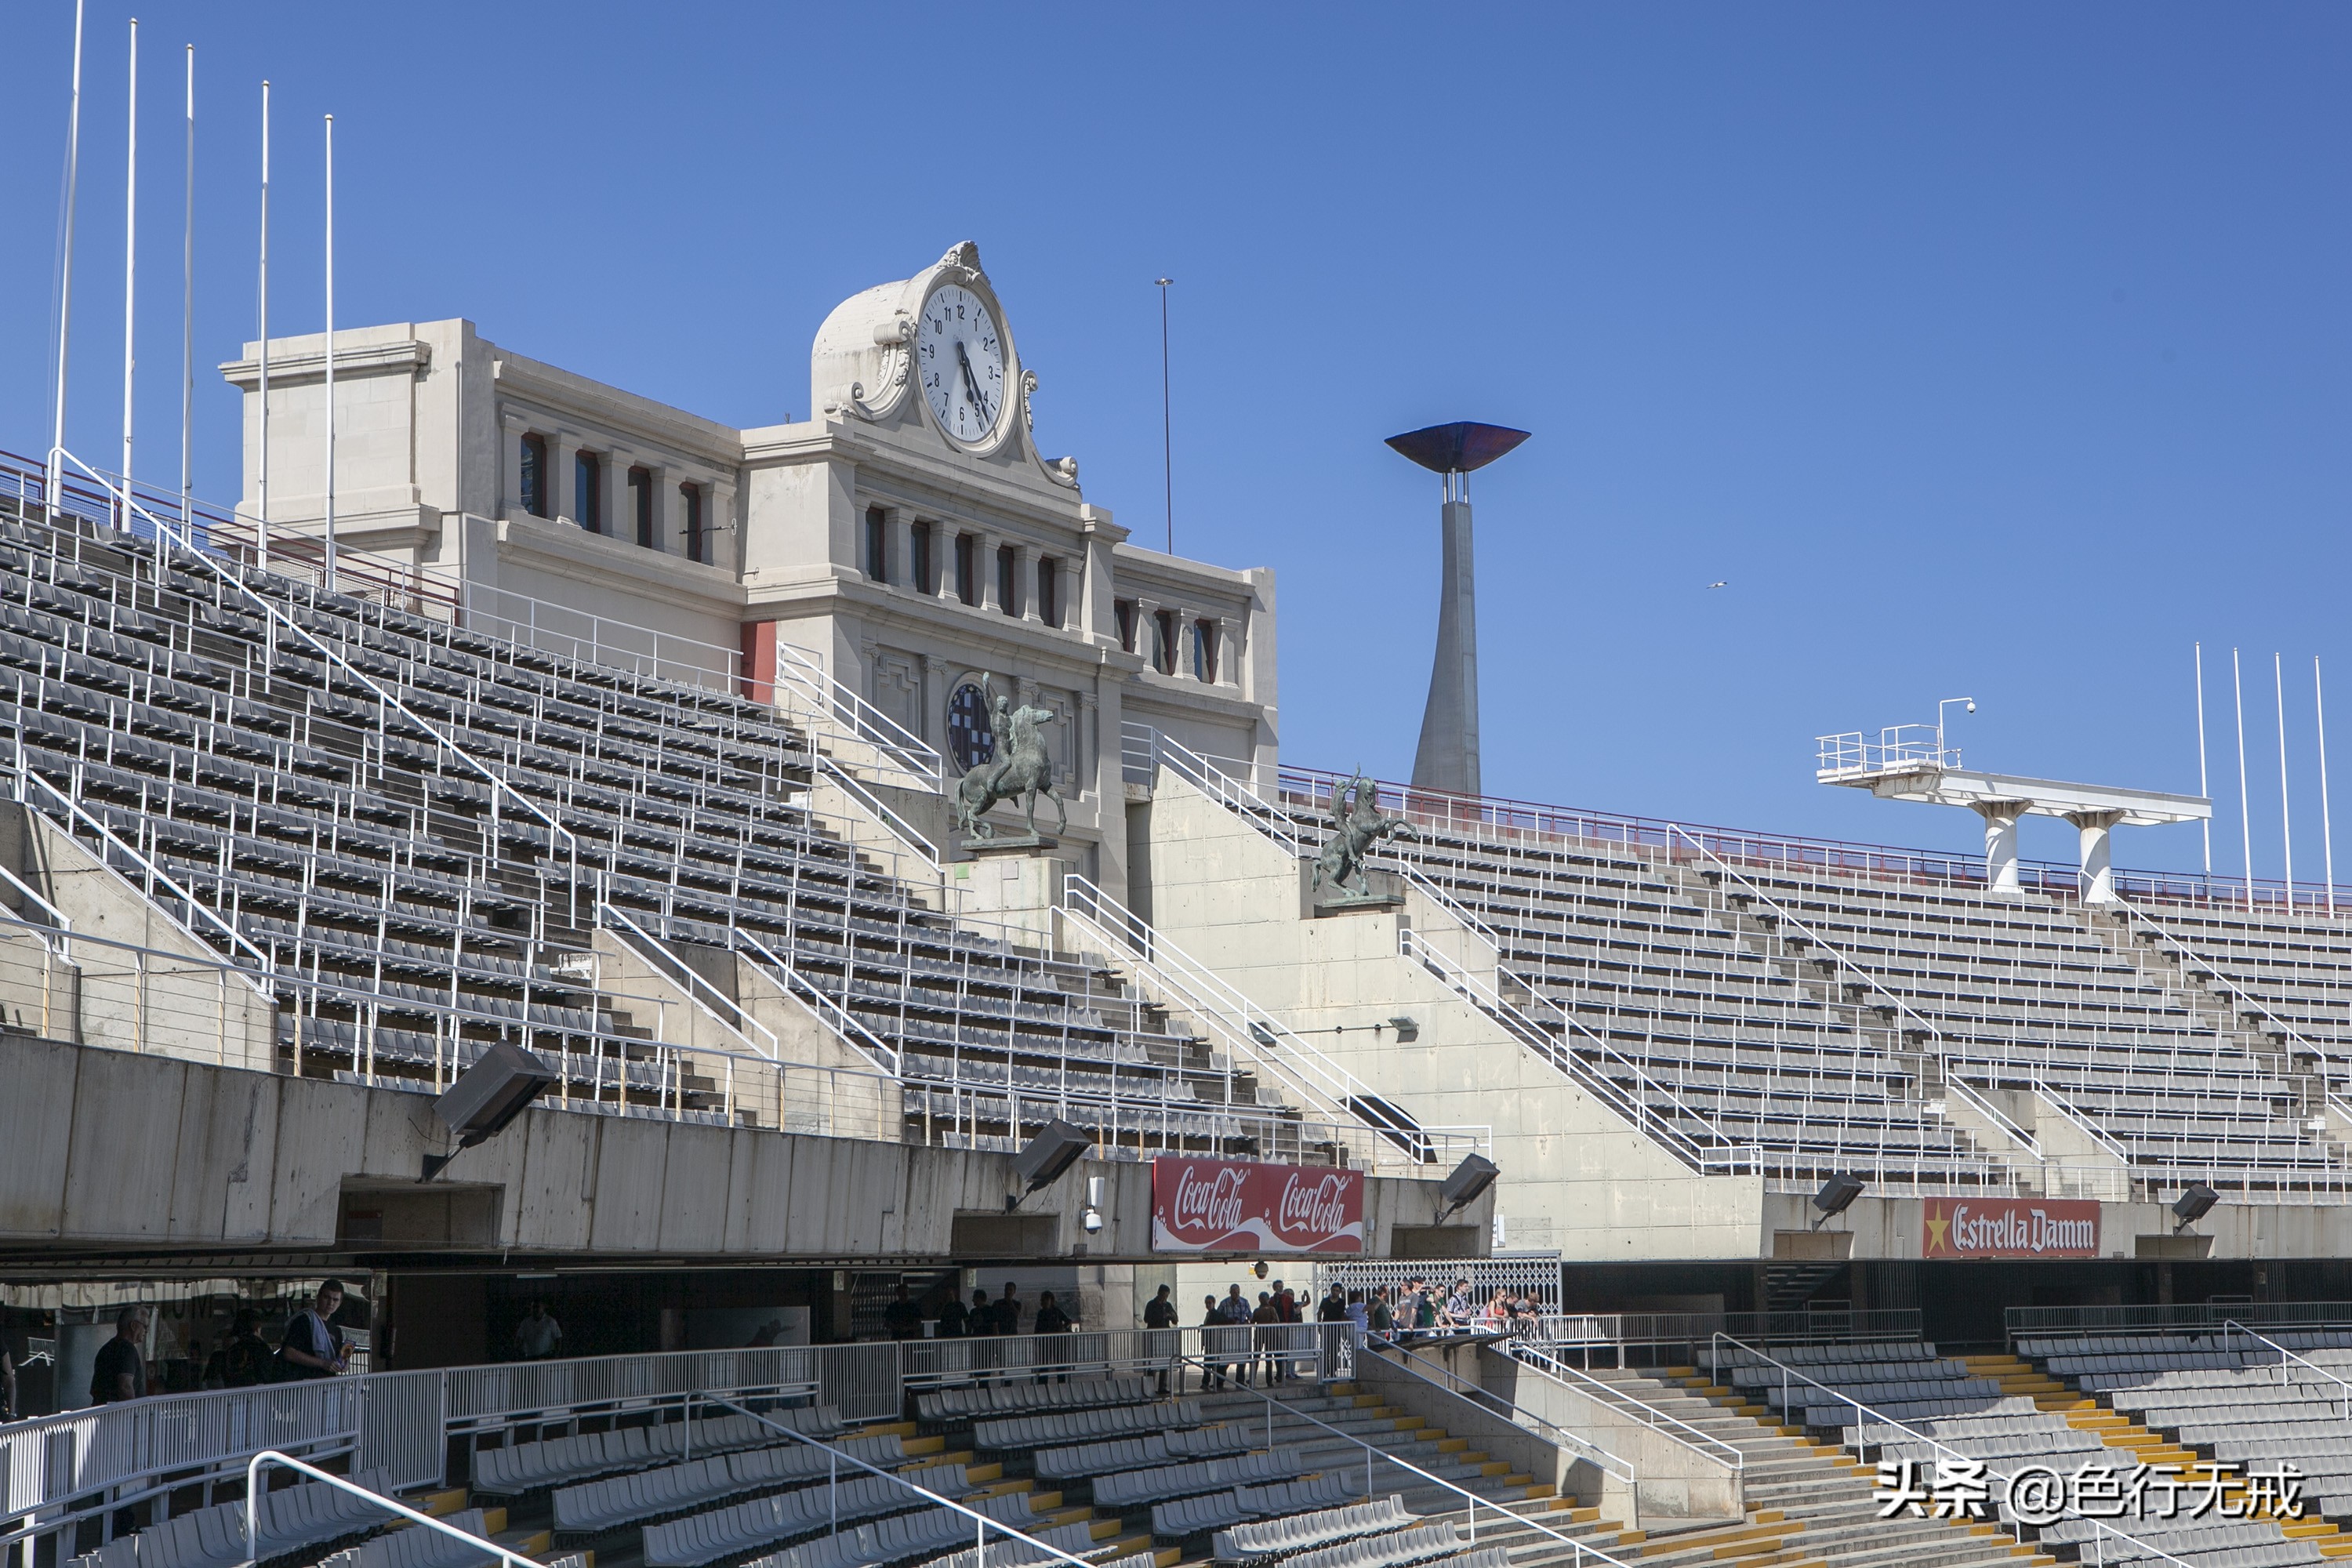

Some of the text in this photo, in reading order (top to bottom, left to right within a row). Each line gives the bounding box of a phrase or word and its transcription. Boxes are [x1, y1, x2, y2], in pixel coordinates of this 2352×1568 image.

[945, 307, 951, 321] 11
[956, 304, 964, 320] 12
[934, 319, 942, 335] 10
[974, 318, 978, 332] 1
[930, 344, 935, 358] 9
[983, 337, 988, 351] 2
[989, 365, 993, 379] 3
[935, 373, 939, 387] 8
[944, 393, 949, 406] 7
[983, 390, 989, 404] 4
[960, 407, 964, 421] 6
[975, 403, 979, 417] 5
[1952, 1203, 2028, 1251] Estrella
[2031, 1208, 2094, 1253] Damm
